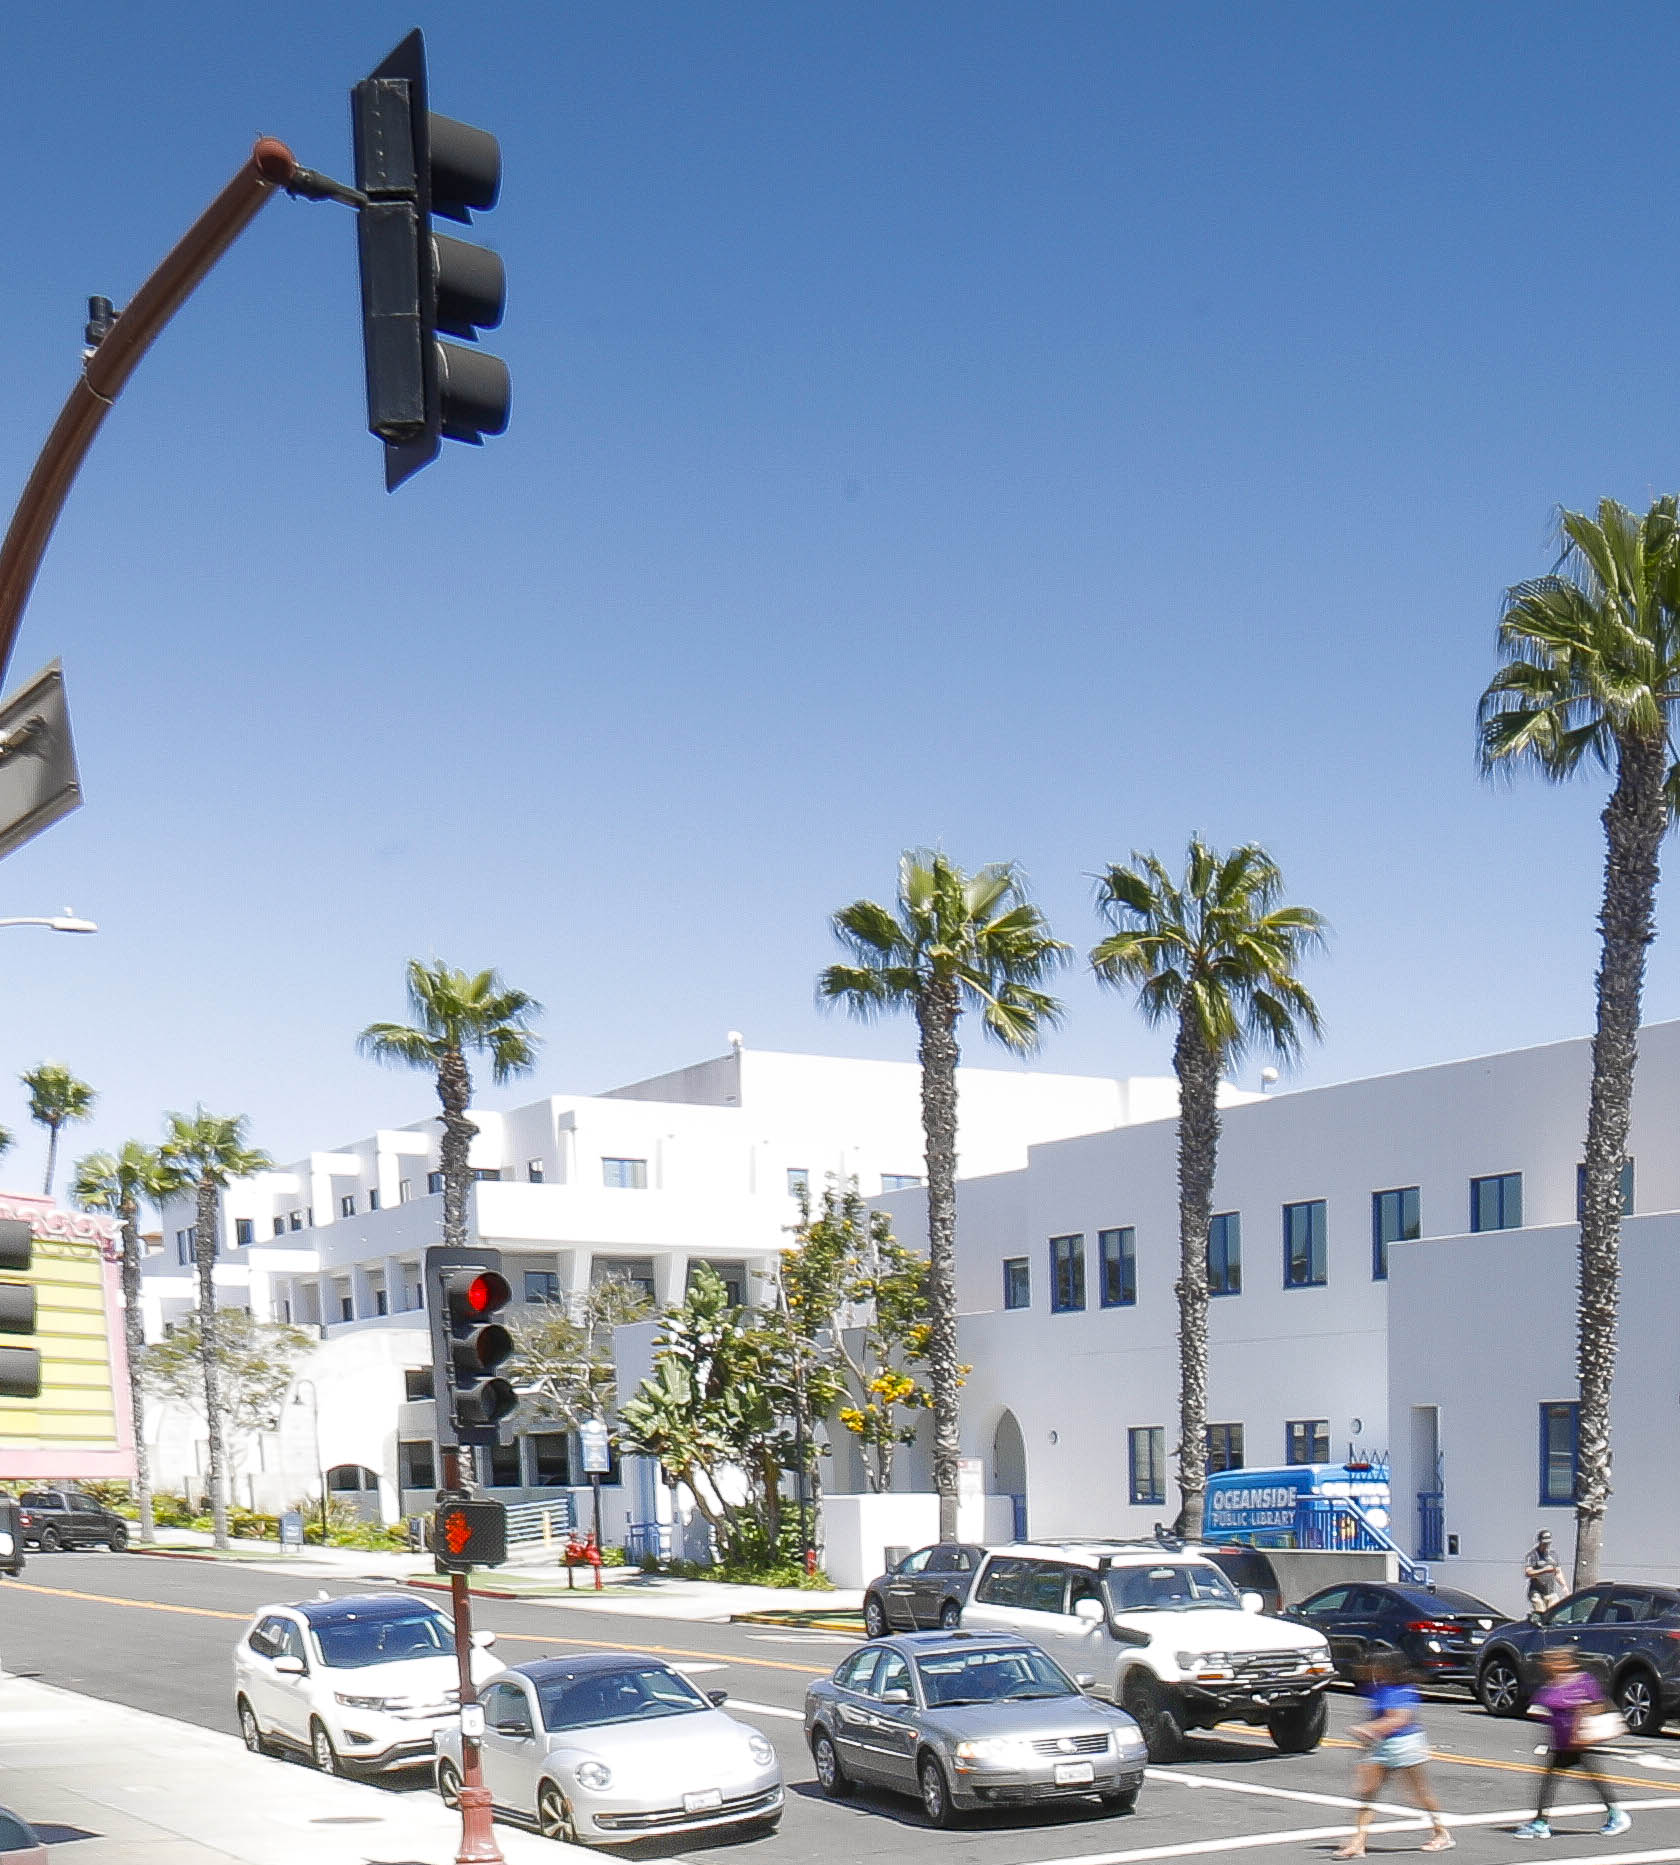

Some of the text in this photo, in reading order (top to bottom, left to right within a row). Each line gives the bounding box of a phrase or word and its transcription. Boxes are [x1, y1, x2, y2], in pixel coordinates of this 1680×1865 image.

[1213, 1486, 1298, 1510] OCEANSIDE
[1212, 1510, 1296, 1527] PUBLIC LIBRARY
